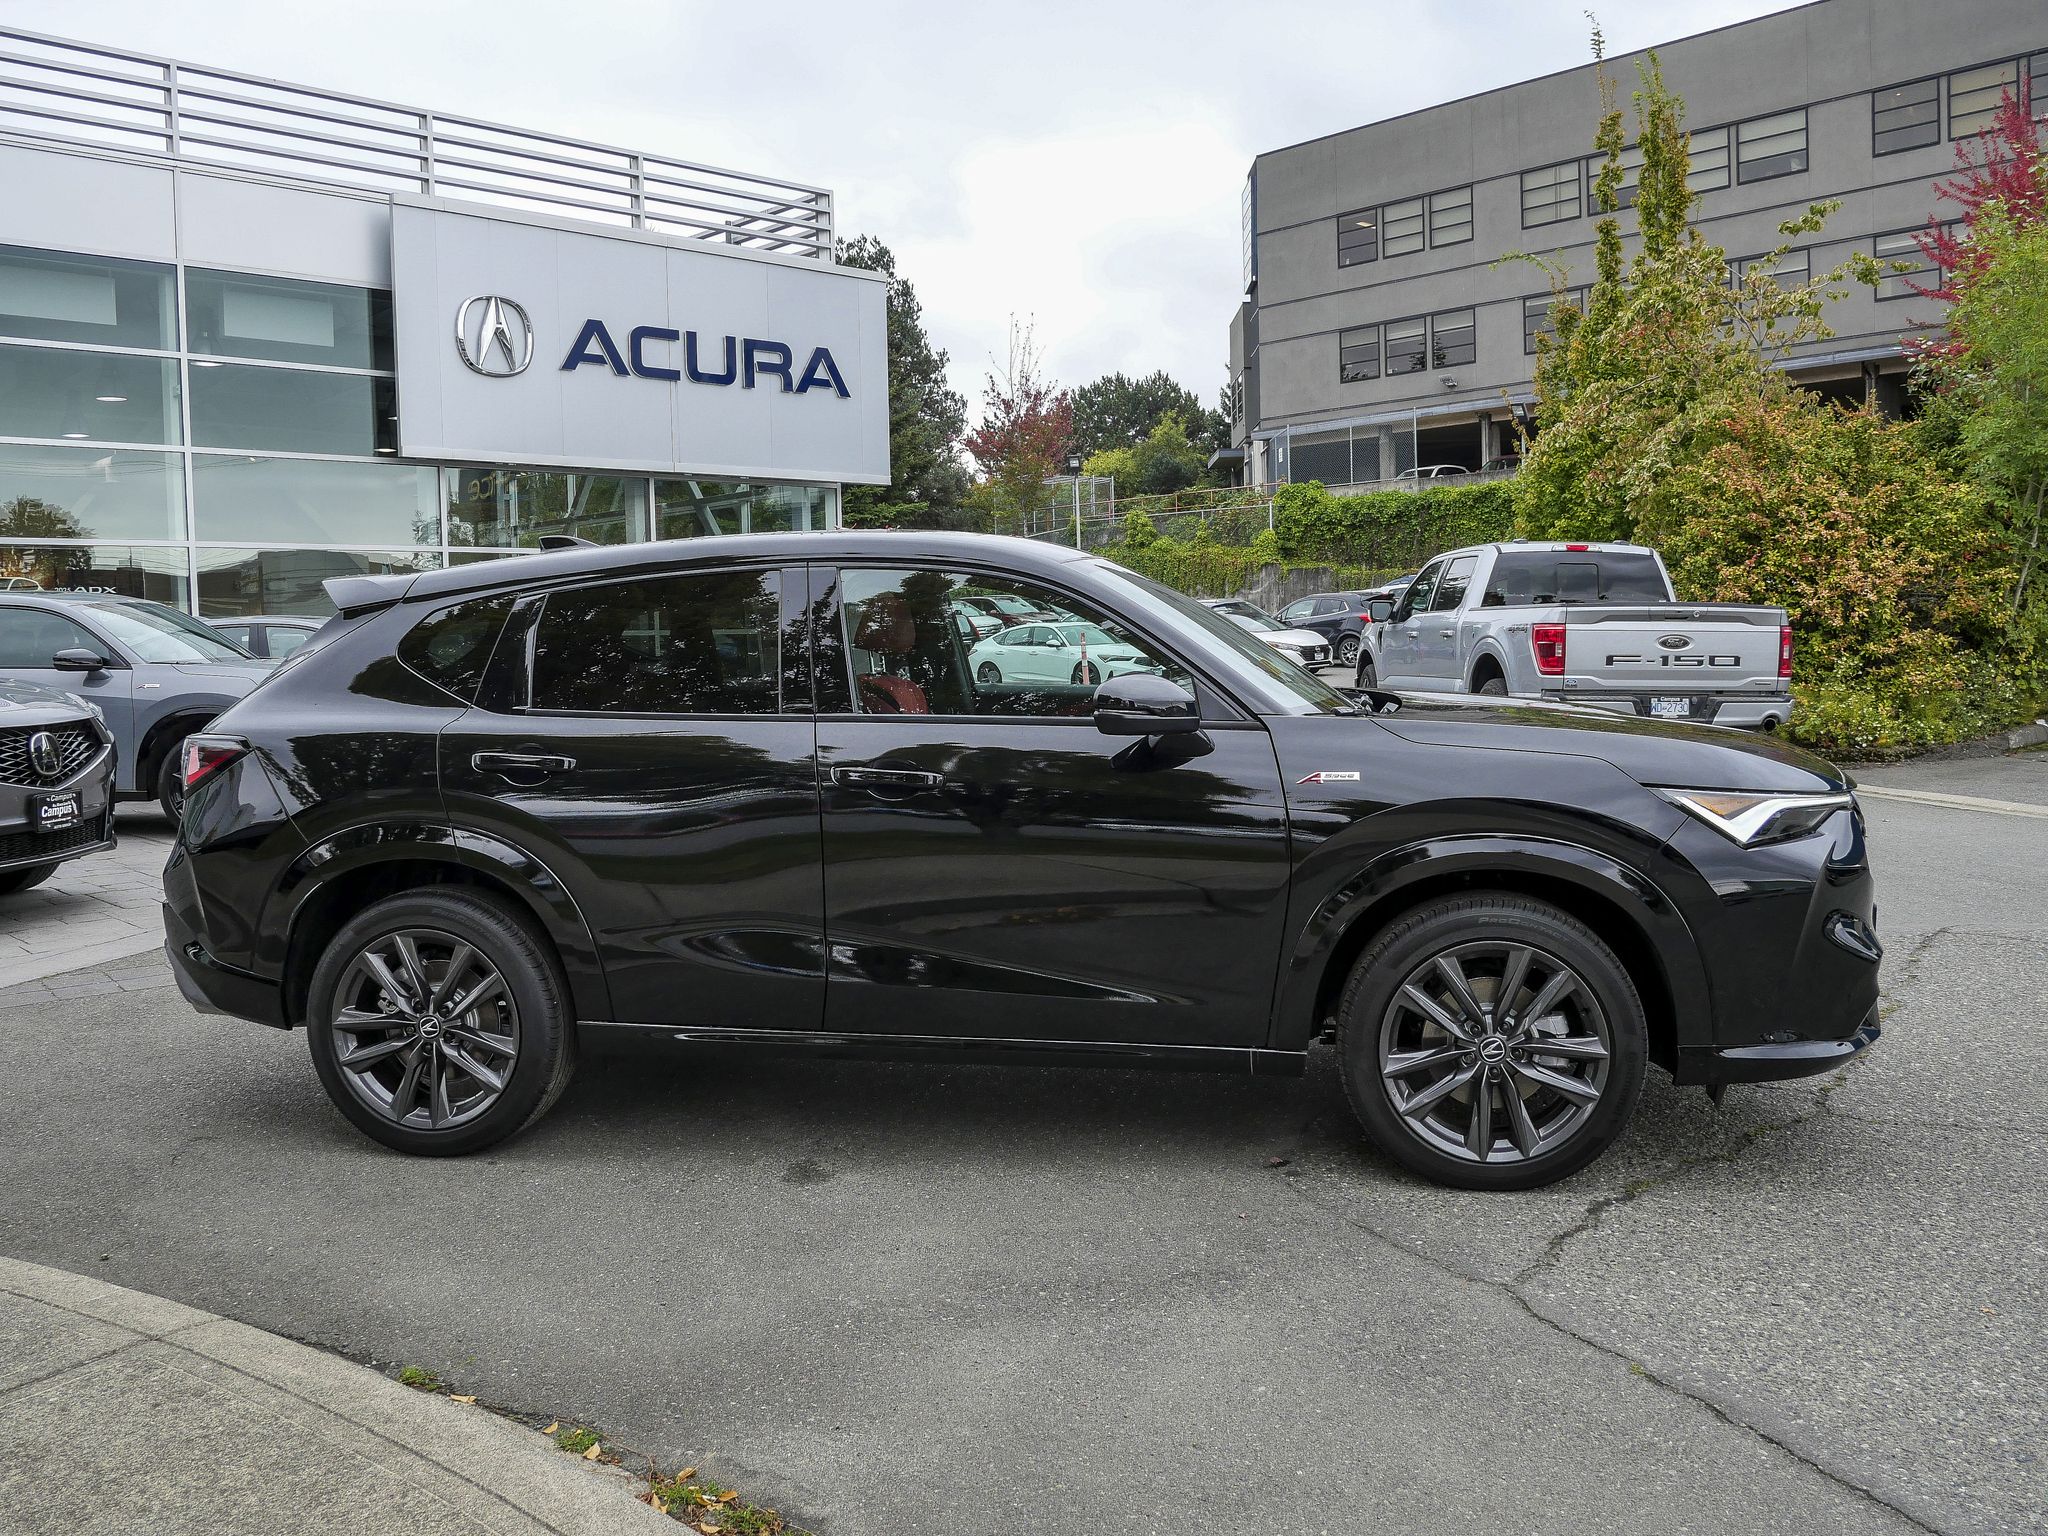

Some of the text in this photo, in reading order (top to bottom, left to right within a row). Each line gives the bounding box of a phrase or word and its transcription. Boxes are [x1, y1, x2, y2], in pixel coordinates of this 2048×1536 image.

[559, 318, 852, 399] ACURA
[1604, 655, 1742, 668] F-150
[50, 793, 73, 802] Campus
[41, 804, 72, 817] Campus
